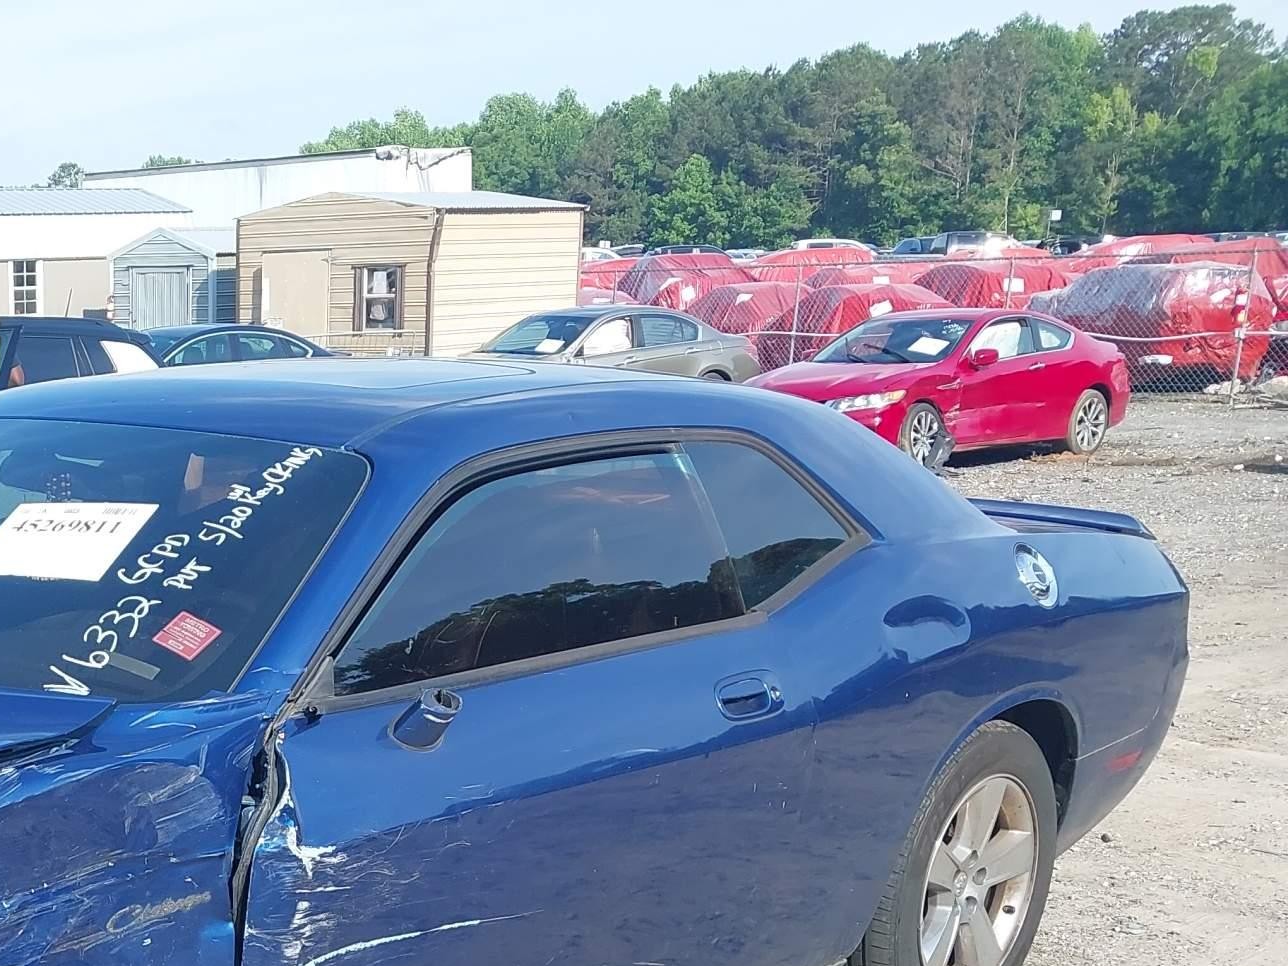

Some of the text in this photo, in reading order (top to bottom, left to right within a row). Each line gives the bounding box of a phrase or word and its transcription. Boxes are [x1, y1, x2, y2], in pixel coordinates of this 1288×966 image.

[12, 514, 122, 534] 45269811
[198, 506, 253, 546] 5/20
[117, 533, 190, 585] GCPD
[62, 595, 162, 669] 6332
[43, 665, 91, 696] V
